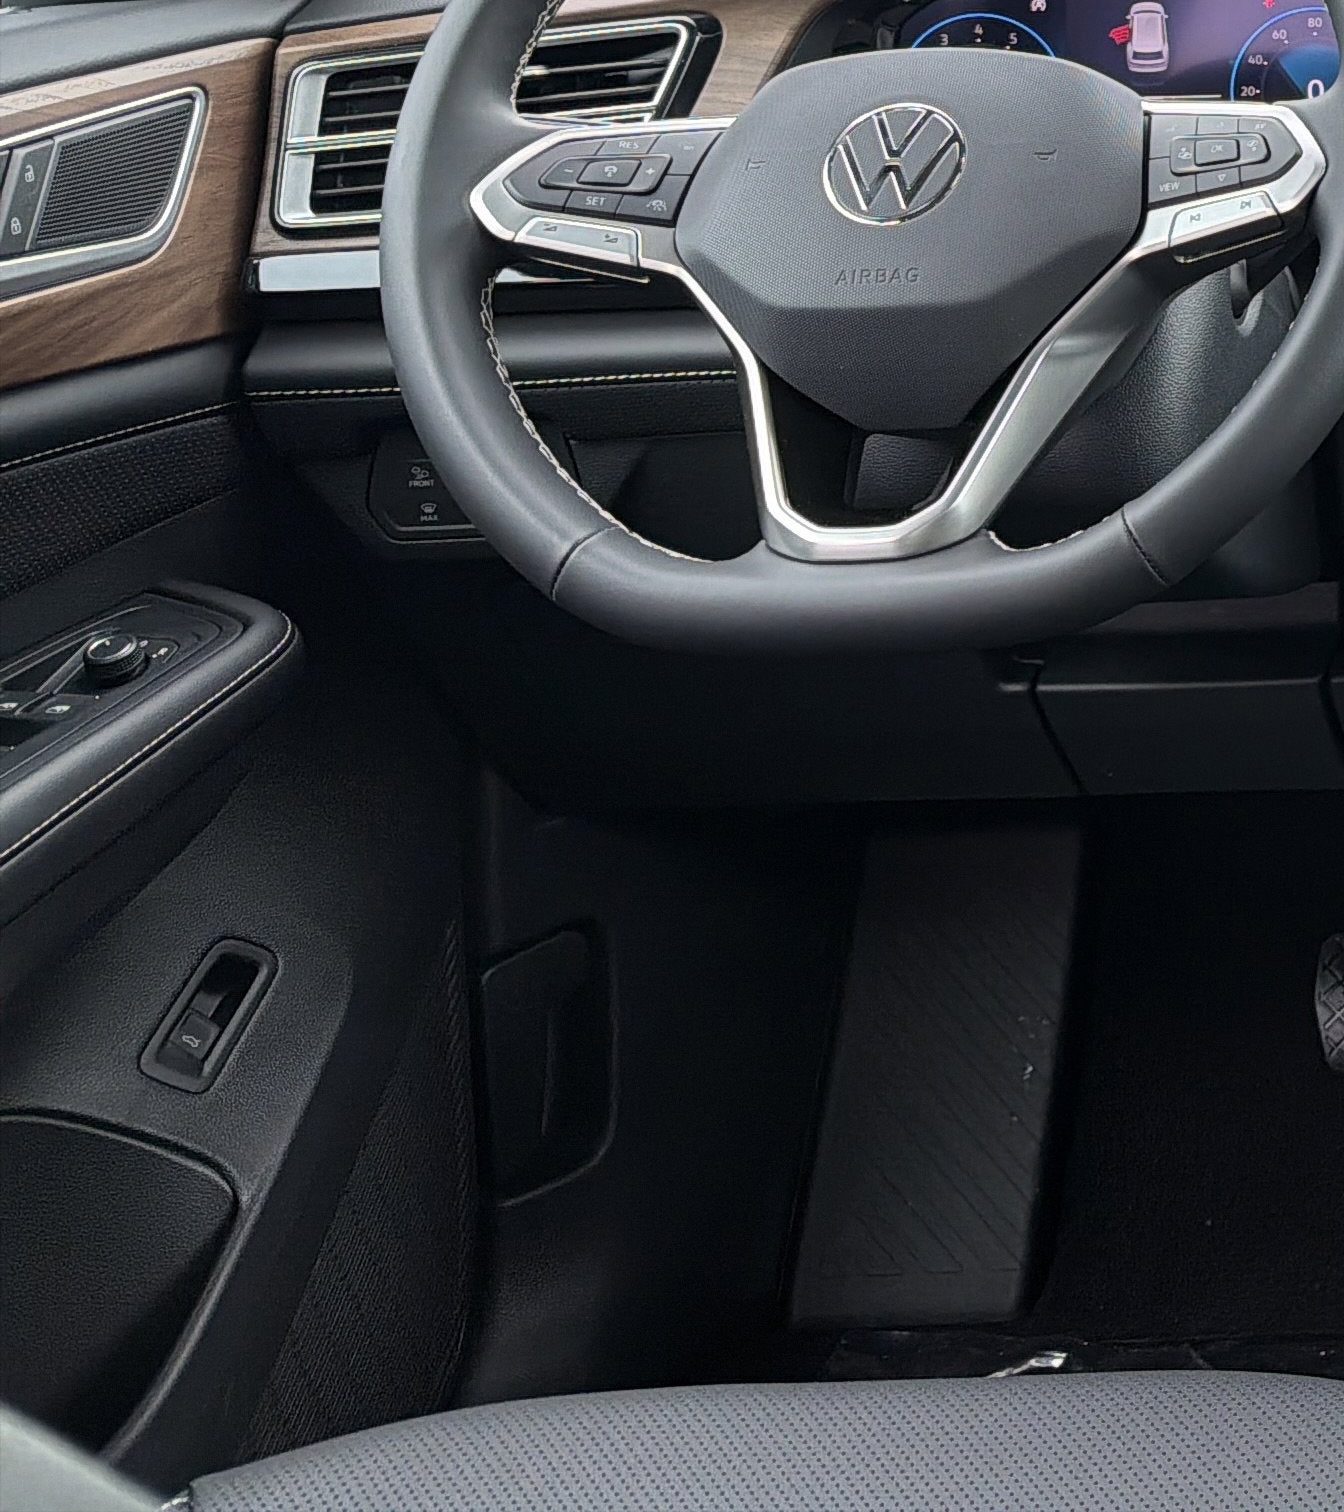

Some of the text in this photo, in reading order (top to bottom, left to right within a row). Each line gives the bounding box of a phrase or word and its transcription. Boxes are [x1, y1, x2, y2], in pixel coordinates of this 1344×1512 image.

[1307, 17, 1323, 28] 80
[974, 23, 983, 36] 4
[1272, 29, 1287, 40] 60
[938, 33, 949, 46] 3
[1008, 32, 1018, 45] 5
[1248, 55, 1263, 66] 40
[1240, 86, 1256, 97] 20
[1307, 79, 1325, 99] 0
[618, 140, 640, 150] RES
[1210, 144, 1224, 153] OK
[1159, 181, 1181, 193] VIEW
[585, 195, 607, 206] SET
[834, 267, 920, 286] AIRBAG
[408, 479, 435, 487] FRONT
[420, 514, 438, 522] MAX
